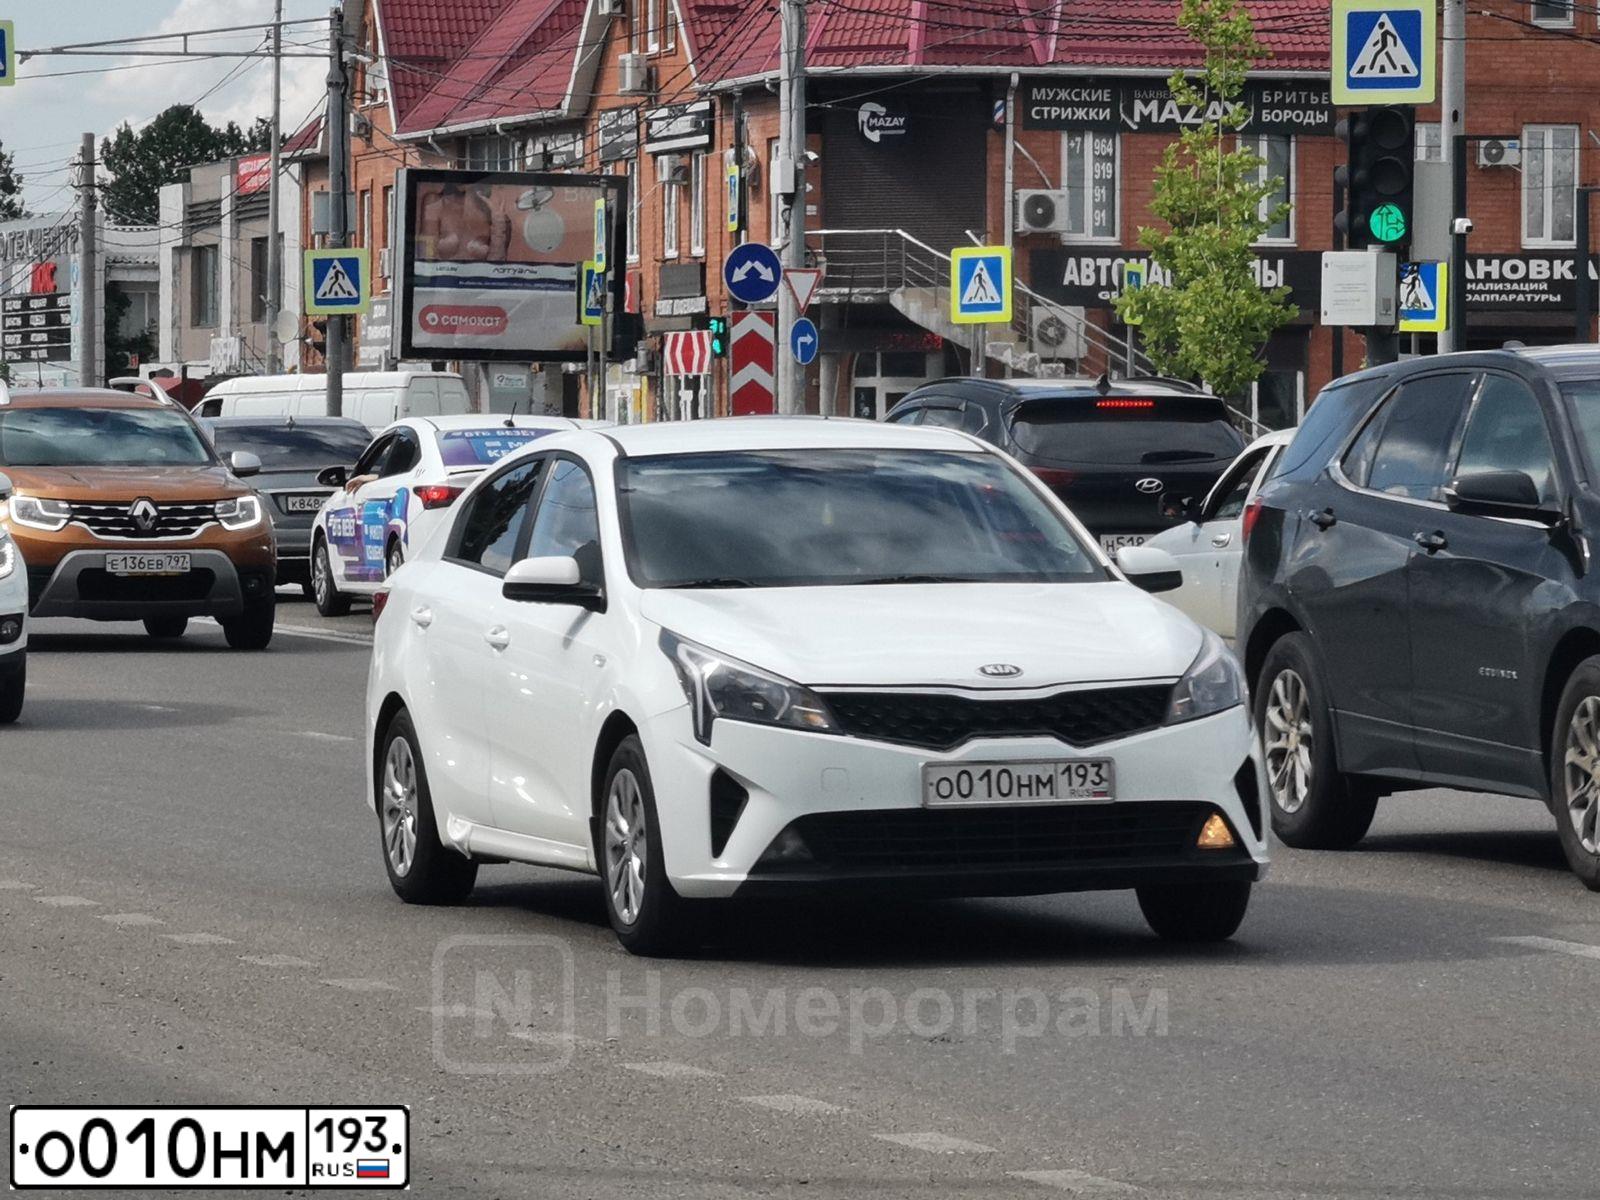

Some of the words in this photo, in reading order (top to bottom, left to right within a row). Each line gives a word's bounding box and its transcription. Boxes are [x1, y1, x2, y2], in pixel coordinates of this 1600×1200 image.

[1032, 88, 1111, 101] МУЖСКИЕ
[1262, 90, 1329, 104] БРИТЬЕ
[1031, 106, 1110, 120] СТРИЖКИ
[1261, 108, 1328, 125] БОРОДЫ
[869, 117, 905, 127] MAZAY
[1069, 137, 1082, 153] +7
[1094, 139, 1113, 156] 964
[1094, 163, 1112, 179] 919
[1094, 186, 1106, 202] 91
[1094, 210, 1106, 226] 91
[441, 315, 501, 327] самокат
[110, 556, 164, 571] Е136ЕВ
[983, 664, 1016, 676] KIA
[935, 768, 1054, 799] О010НМ
[1060, 763, 1103, 787] 193
